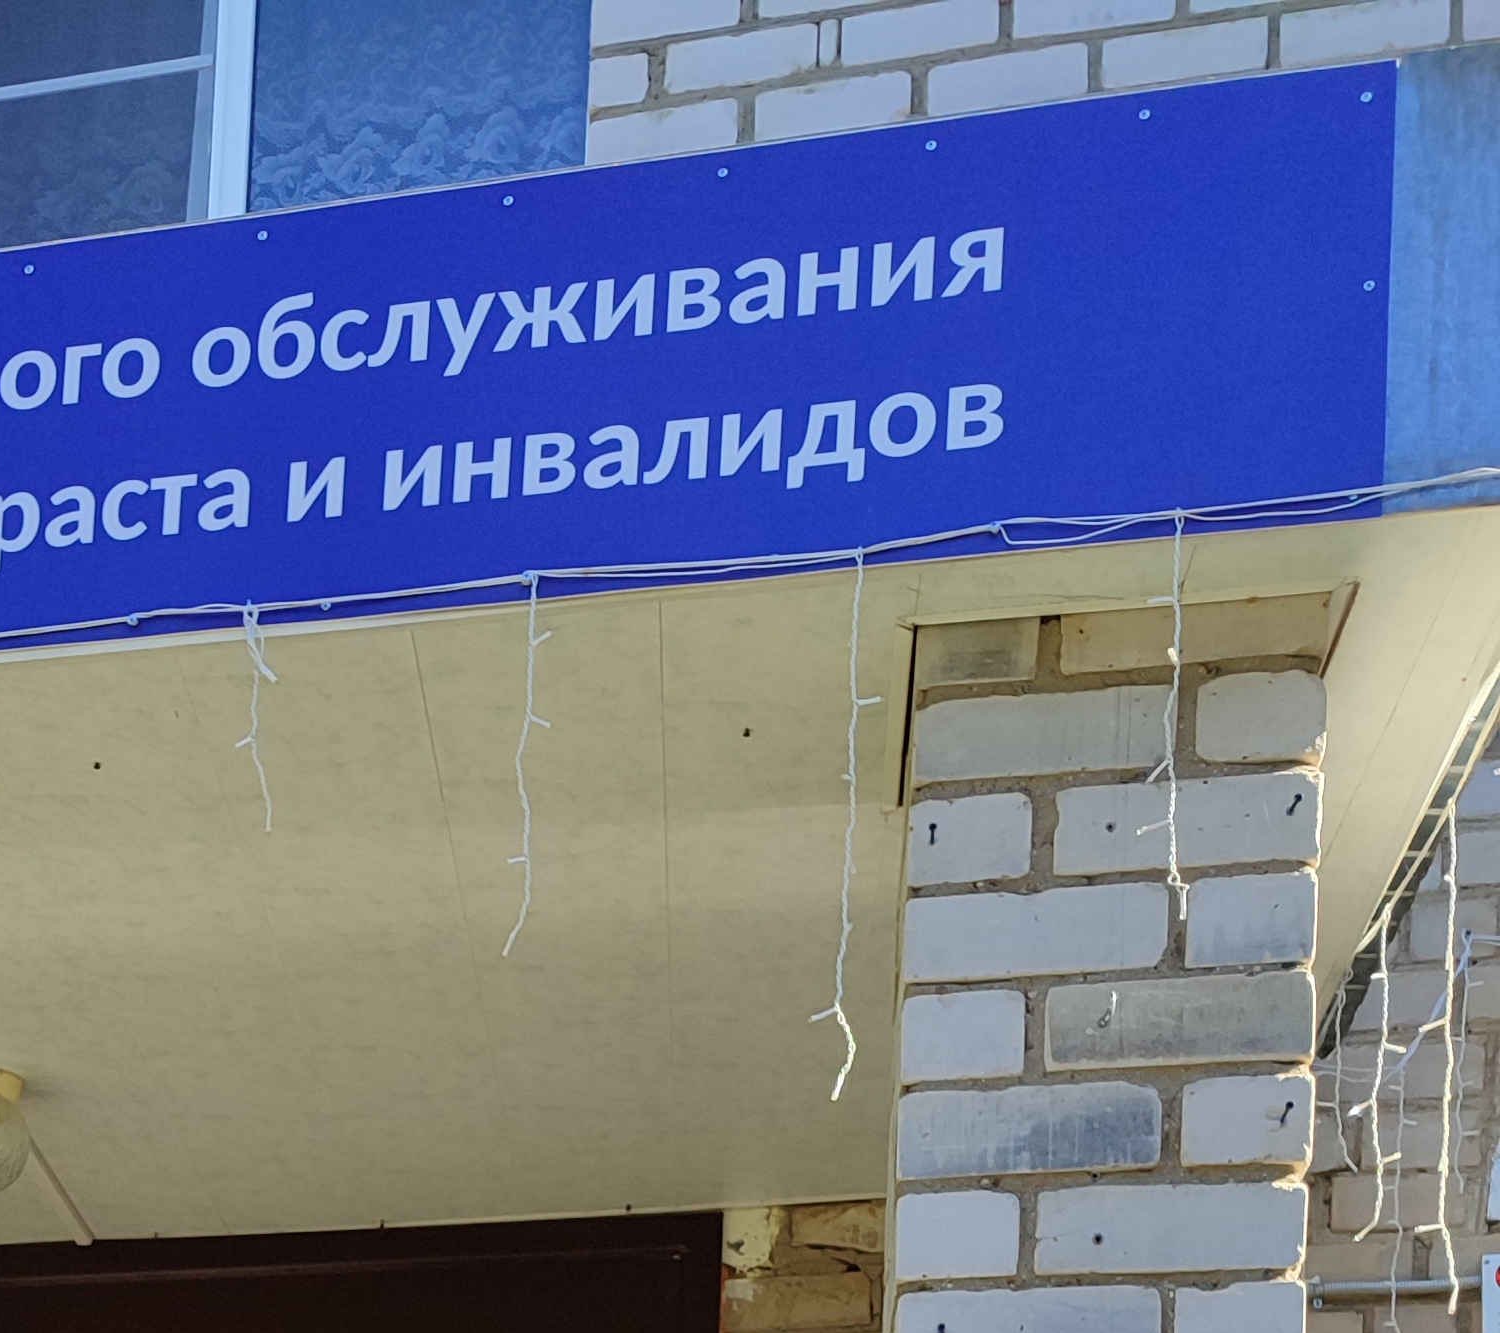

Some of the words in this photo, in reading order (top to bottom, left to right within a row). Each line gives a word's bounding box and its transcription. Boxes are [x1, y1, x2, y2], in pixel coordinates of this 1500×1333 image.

[192, 226, 1005, 388] обслуживания
[286, 456, 346, 523] и
[382, 383, 1004, 511] инвалидов
